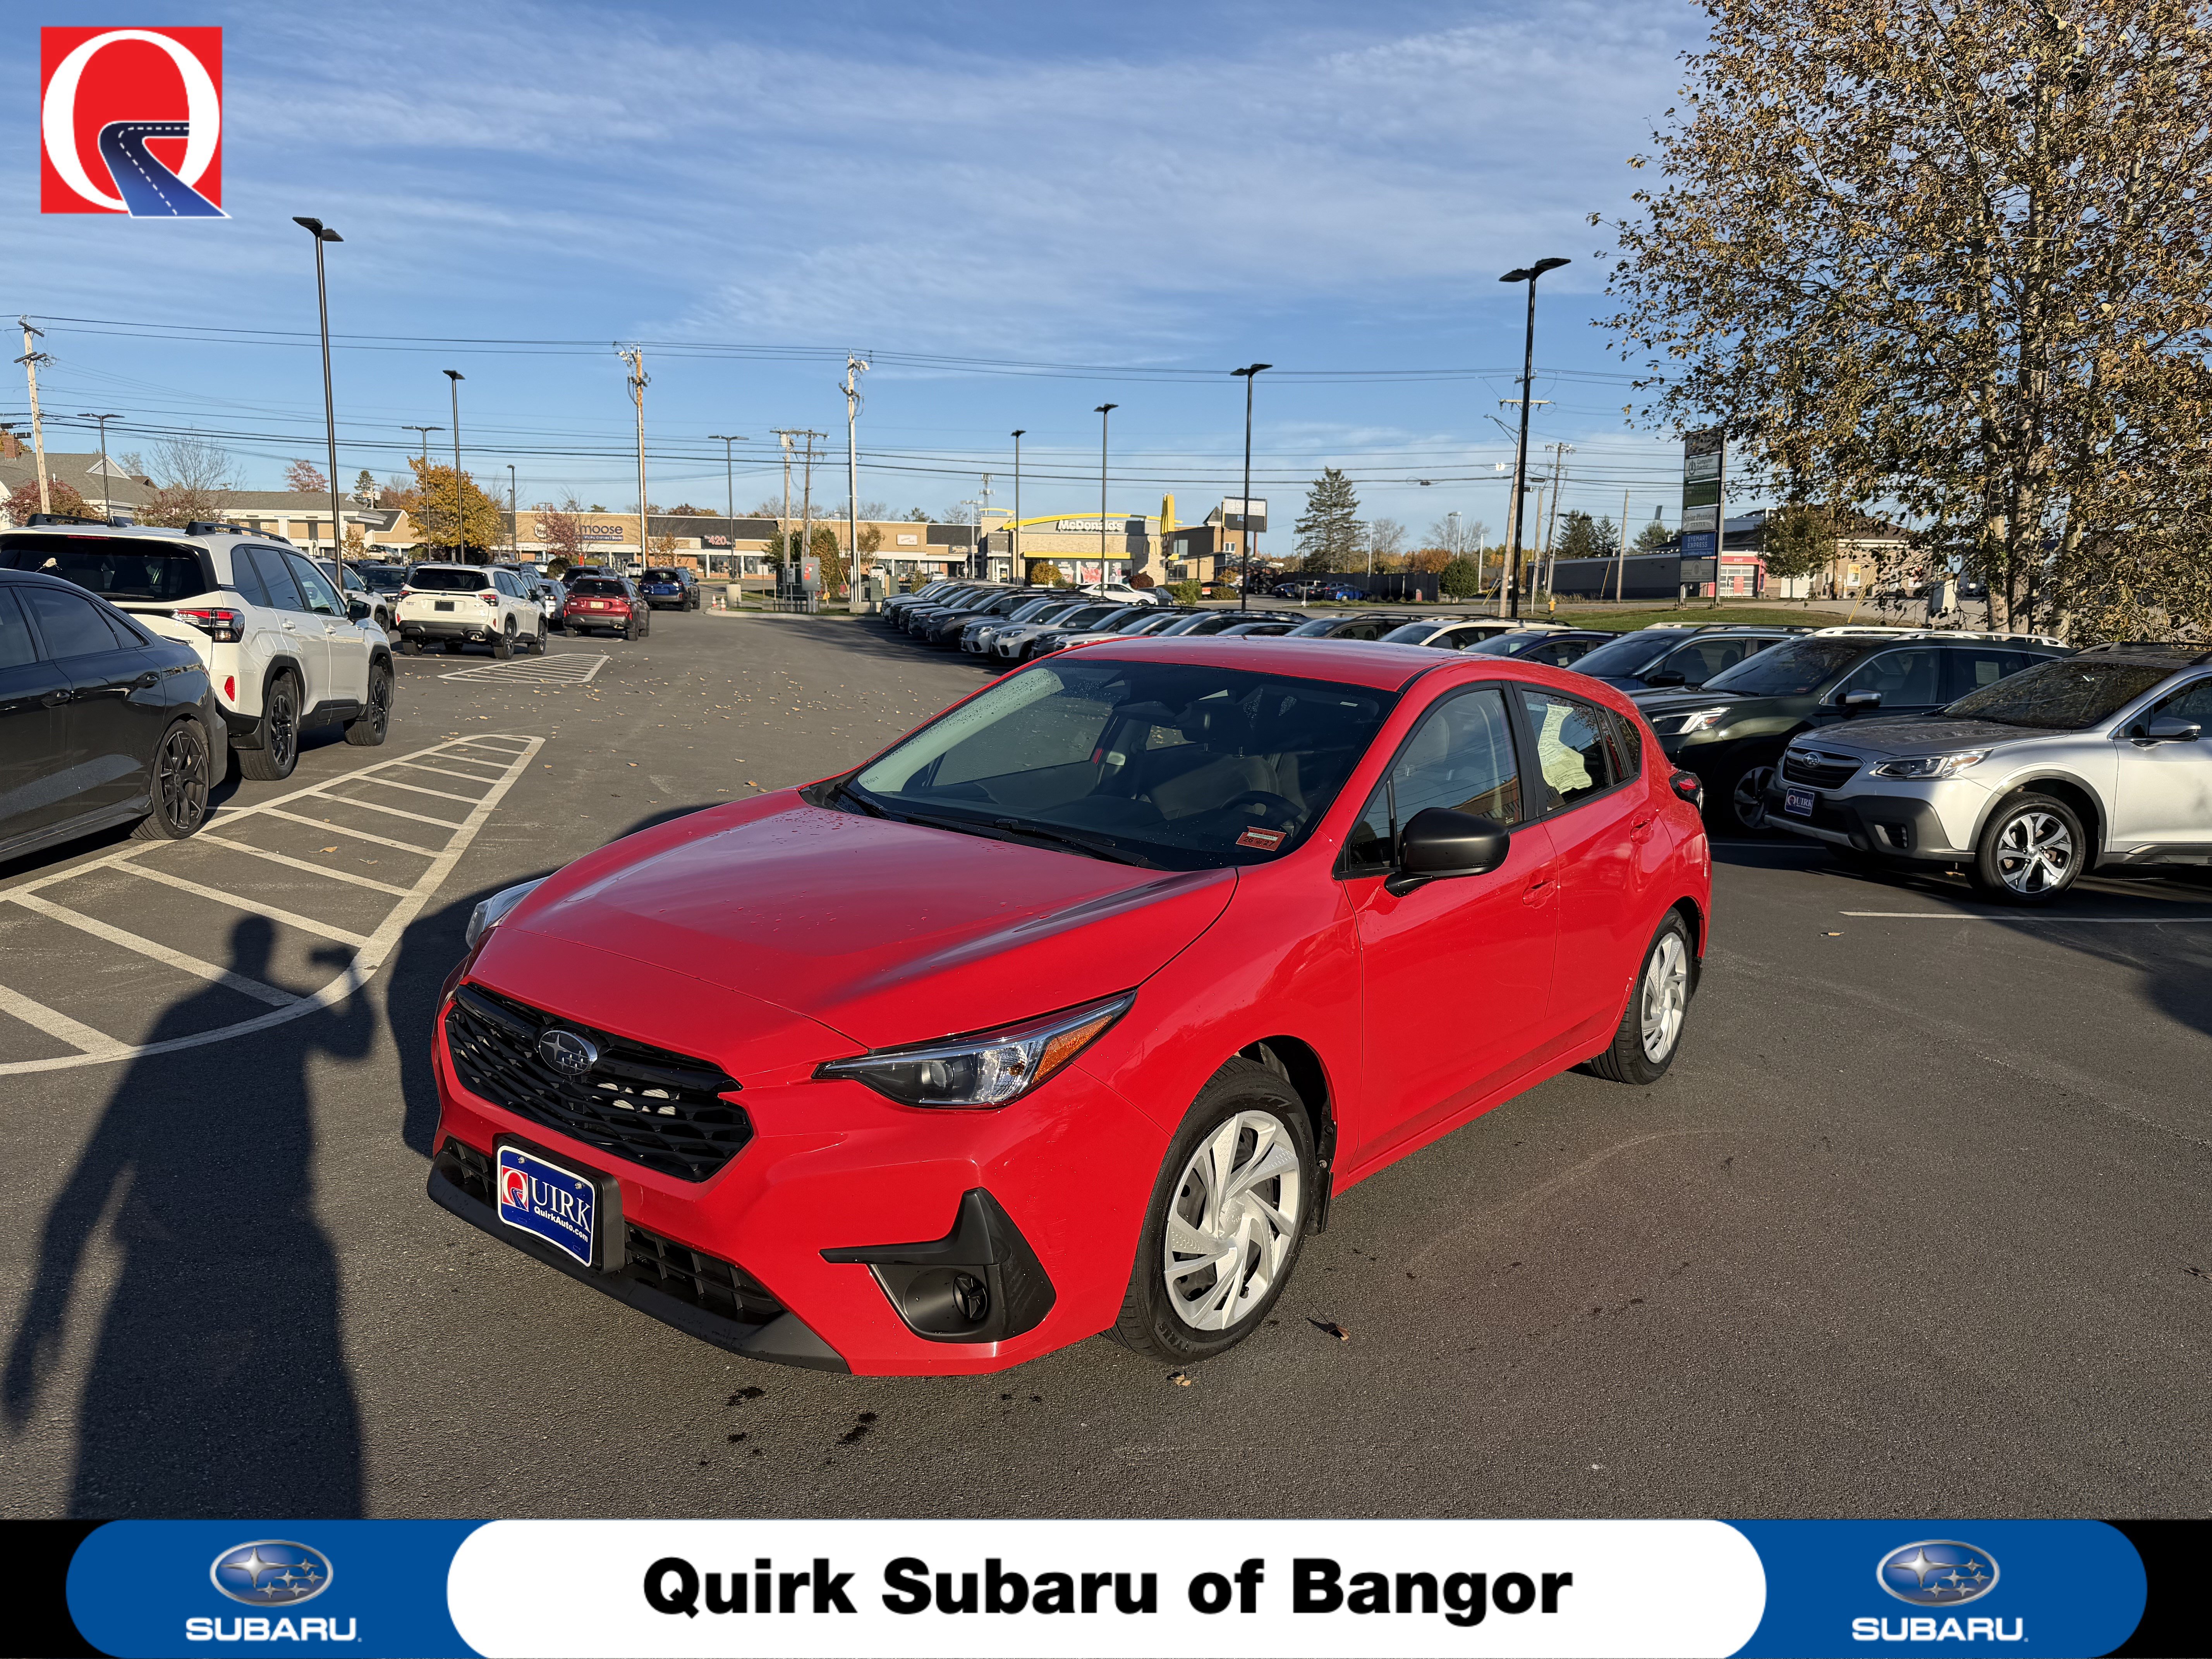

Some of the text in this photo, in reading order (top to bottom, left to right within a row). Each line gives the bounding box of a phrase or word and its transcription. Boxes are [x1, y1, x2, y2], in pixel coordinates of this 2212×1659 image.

[580, 525, 623, 534] moose
[1058, 520, 1123, 531] McDonald's
[709, 536, 727, 545] 420
[502, 1170, 591, 1233] QUIRK
[534, 1206, 588, 1243] QuirkAuto.com
